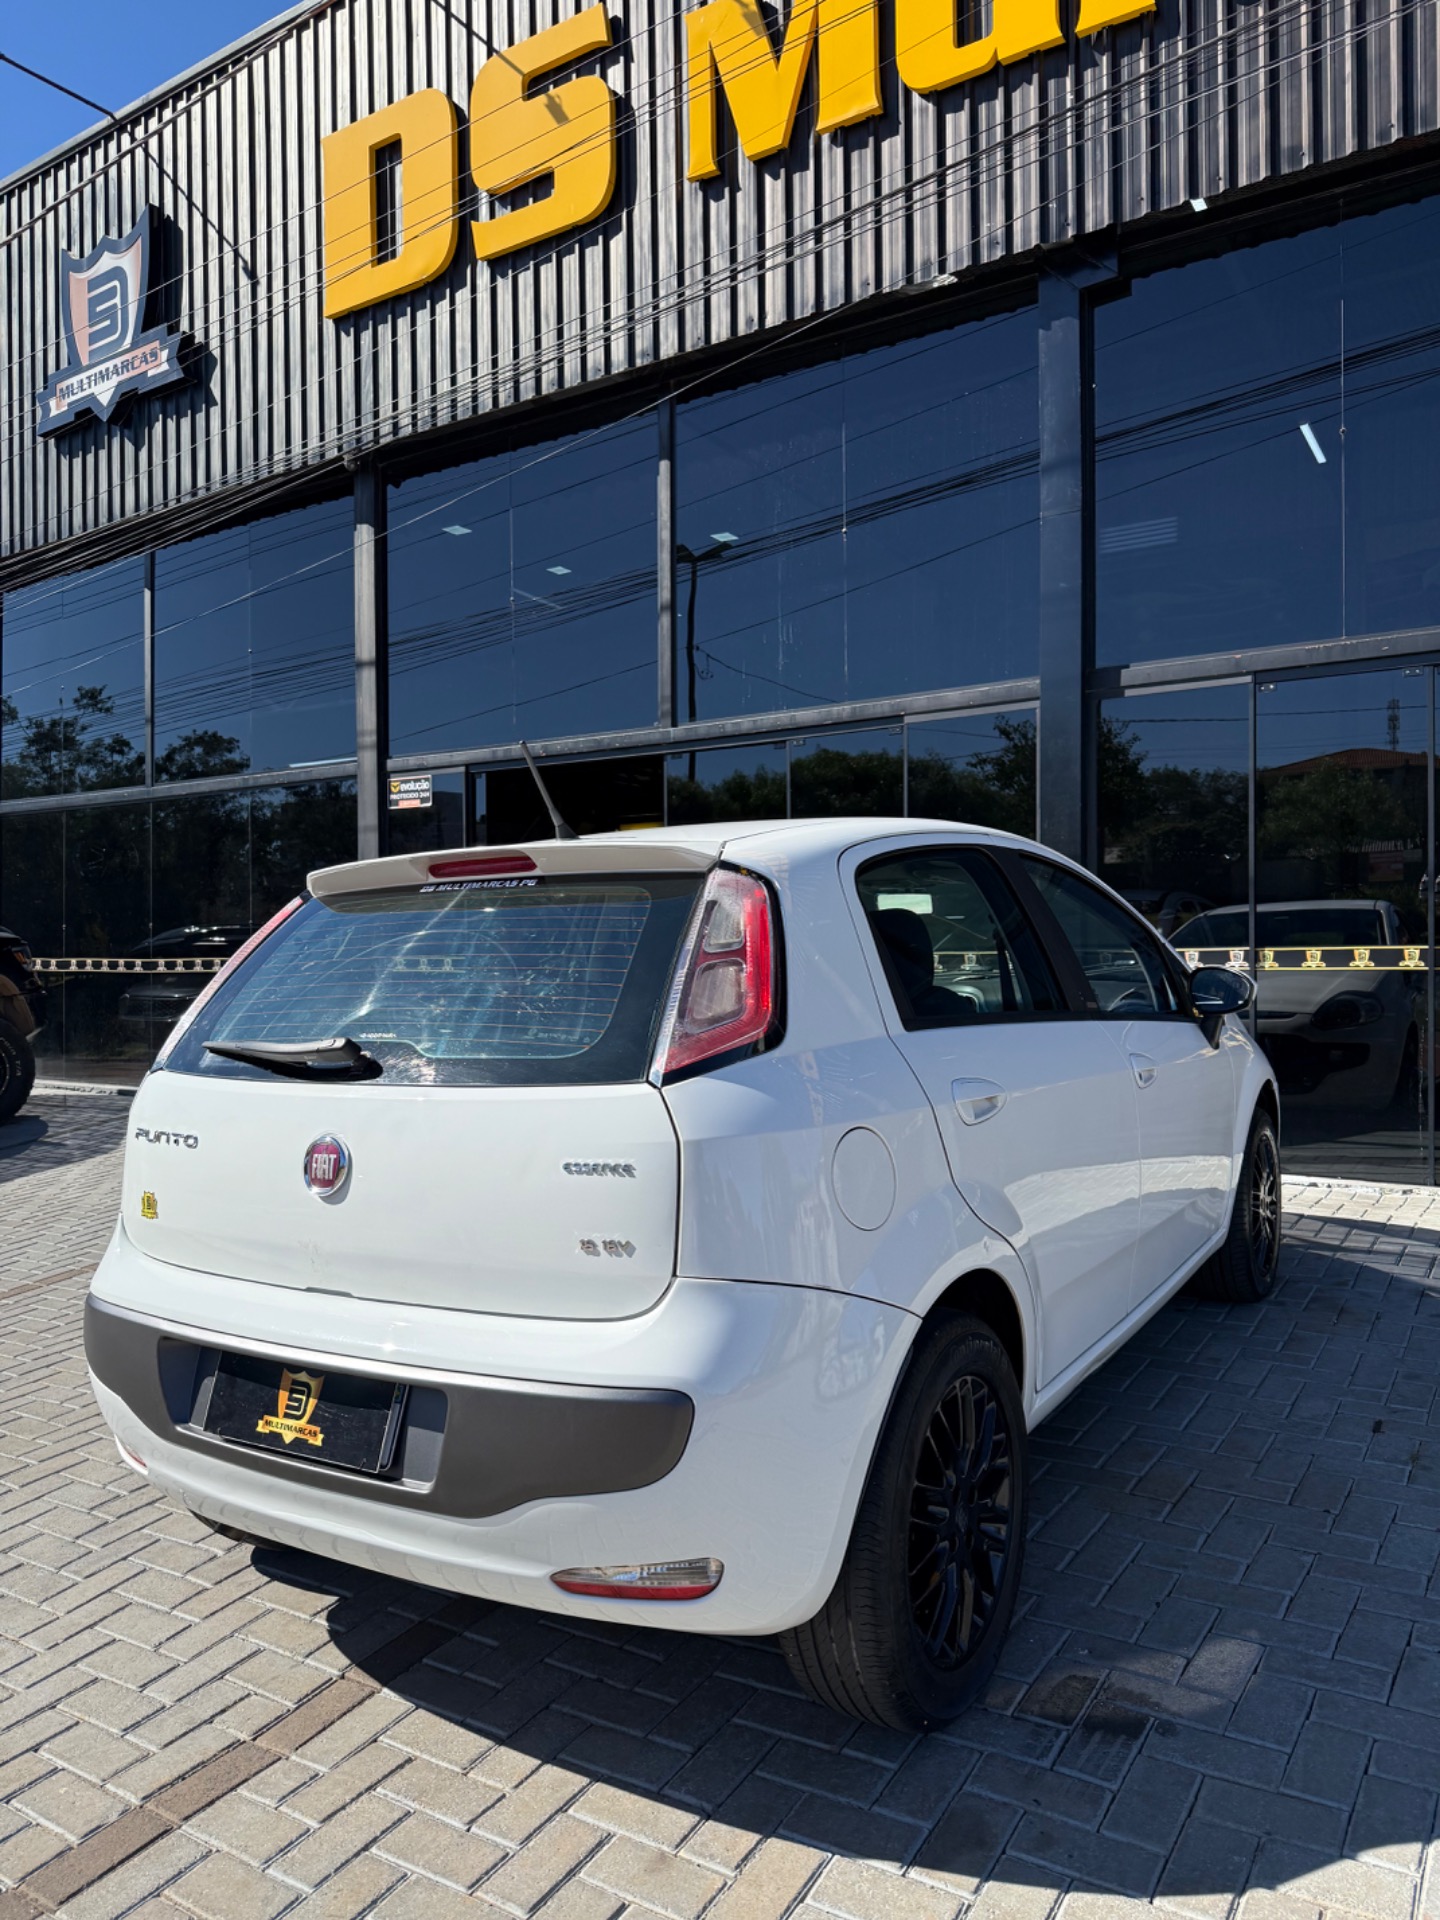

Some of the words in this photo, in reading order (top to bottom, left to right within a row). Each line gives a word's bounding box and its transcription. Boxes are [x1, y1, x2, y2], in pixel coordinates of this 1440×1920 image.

[321, 3, 617, 319] DS
[58, 346, 160, 402] MULTIMARCAS
[400, 779, 429, 791] evolução
[436, 880, 518, 891] MULTIMARCAS
[135, 1127, 198, 1149] PUNTO
[312, 1153, 337, 1180] FIAT
[264, 1419, 317, 1437] MULTIMARCAS
